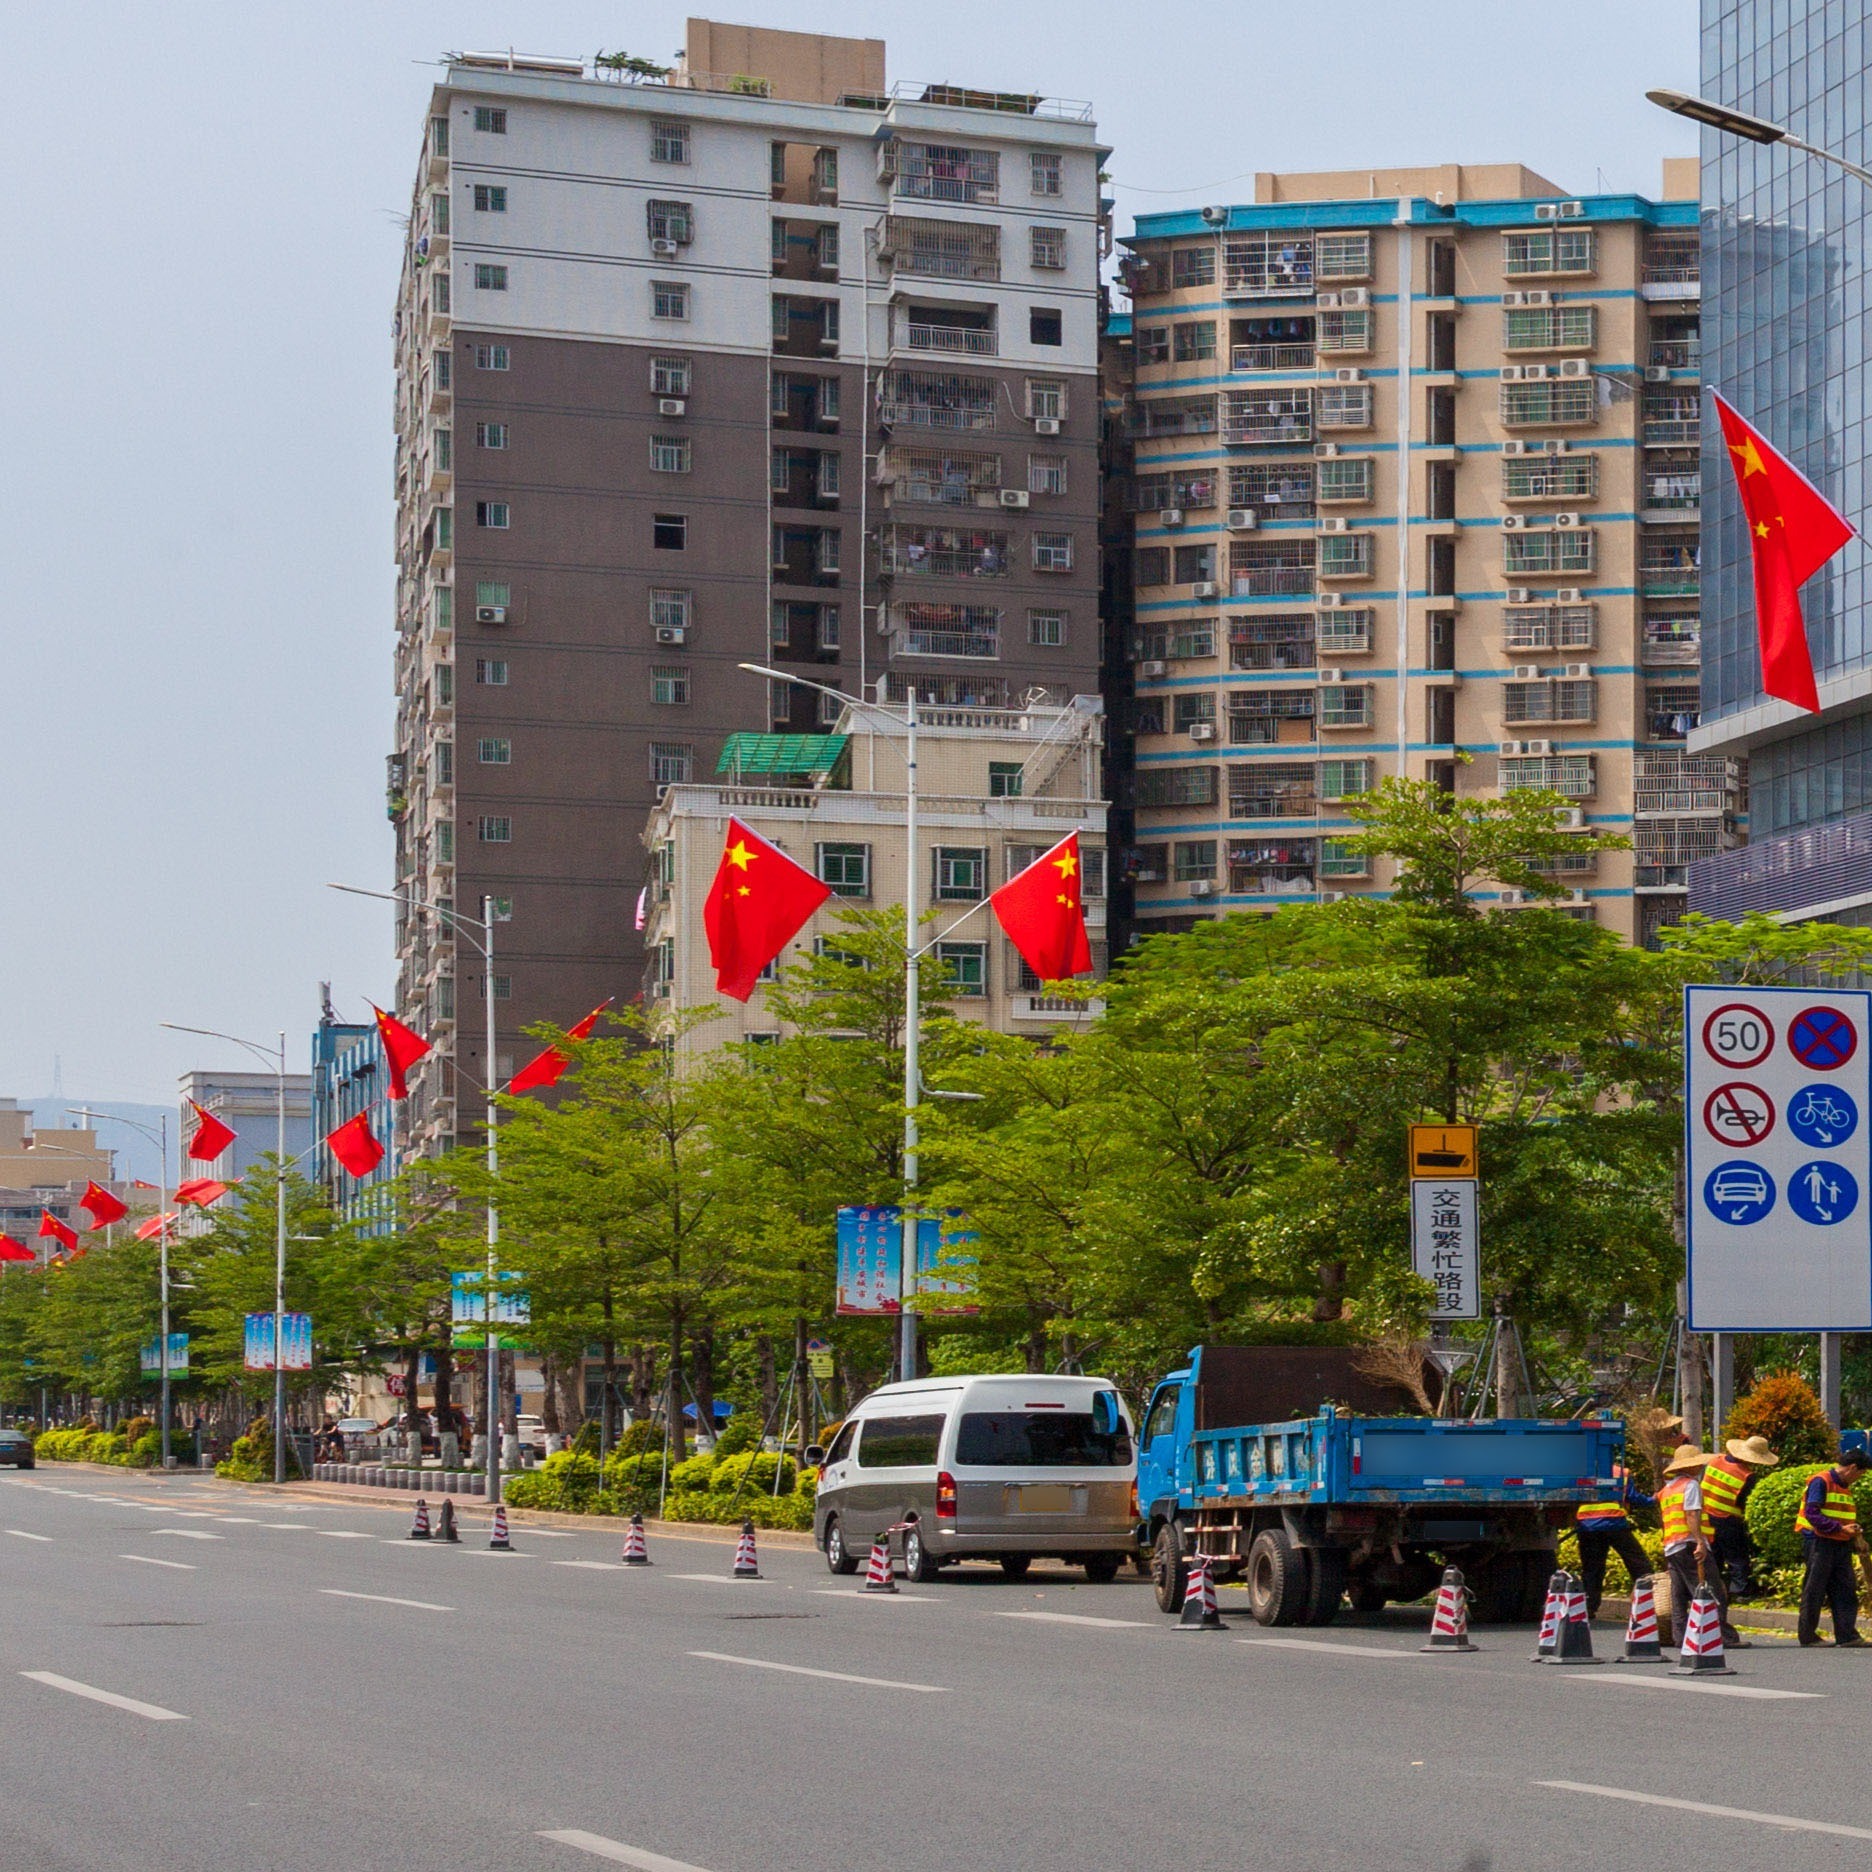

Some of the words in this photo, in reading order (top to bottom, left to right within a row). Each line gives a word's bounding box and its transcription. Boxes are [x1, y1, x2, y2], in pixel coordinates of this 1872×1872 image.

[1718, 1021, 1760, 1051] 50
[1431, 1188, 1463, 1312] 交通繁忙路段
